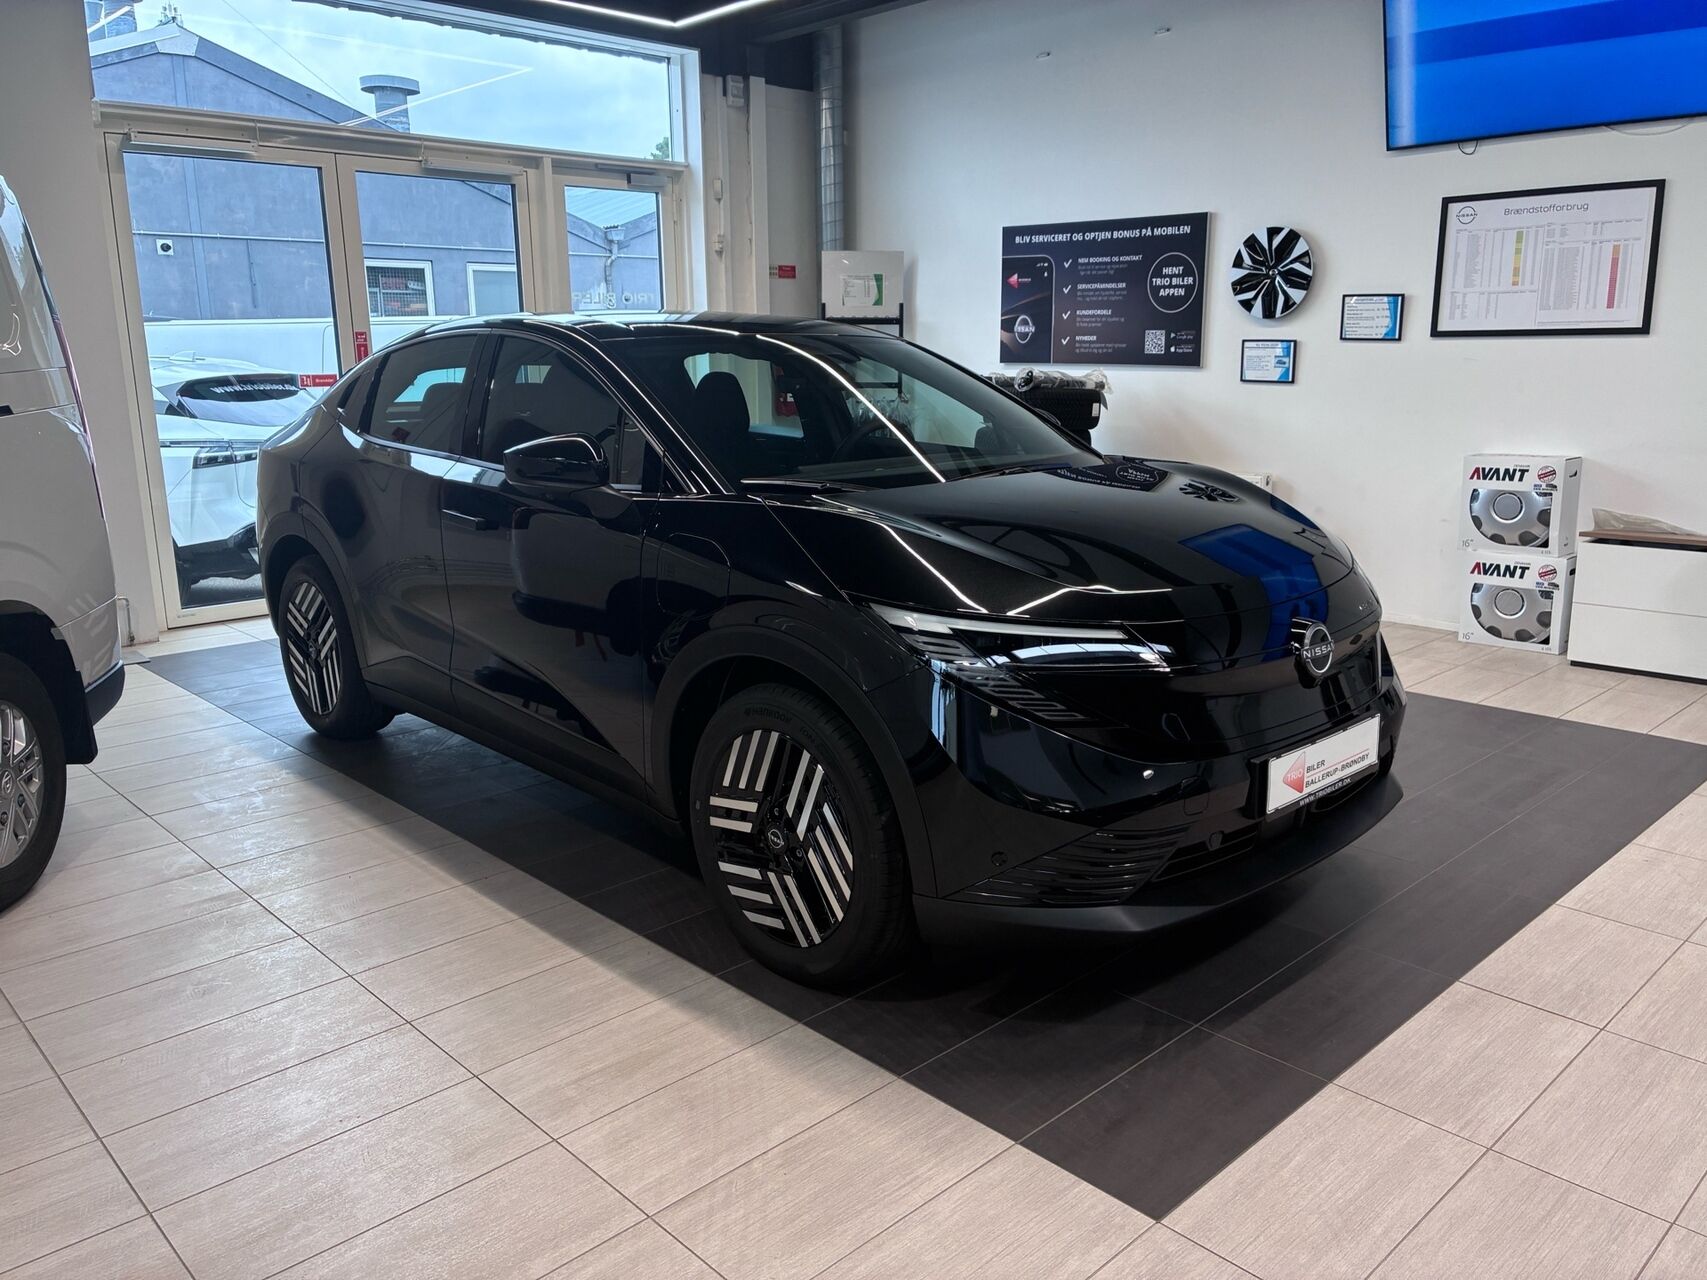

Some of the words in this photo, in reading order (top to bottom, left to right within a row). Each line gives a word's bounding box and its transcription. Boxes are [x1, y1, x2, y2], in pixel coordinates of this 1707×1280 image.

[1503, 202, 1589, 216] Brændstofforbrug
[1015, 235, 1030, 244] BLIV
[1031, 233, 1071, 243] SERVICERET
[1072, 232, 1083, 241] OG
[1084, 230, 1112, 241] OPTJEN
[1113, 229, 1140, 239] BONUS
[1141, 226, 1152, 237] PÅ
[1154, 225, 1191, 236] MOBILEN
[1120, 254, 1143, 262] KONTAKT
[1162, 266, 1184, 275] HENT
[1152, 278, 1170, 286] TRIO
[1171, 276, 1194, 285] BILER
[1159, 288, 1185, 296] APPEN
[1469, 466, 1530, 482] AVANT
[1470, 561, 1530, 580] AVANT
[1287, 768, 1303, 782] TRIO
[1306, 760, 1326, 774] BILER
[1299, 777, 1352, 806] WWW.TRIOBILER.DK
